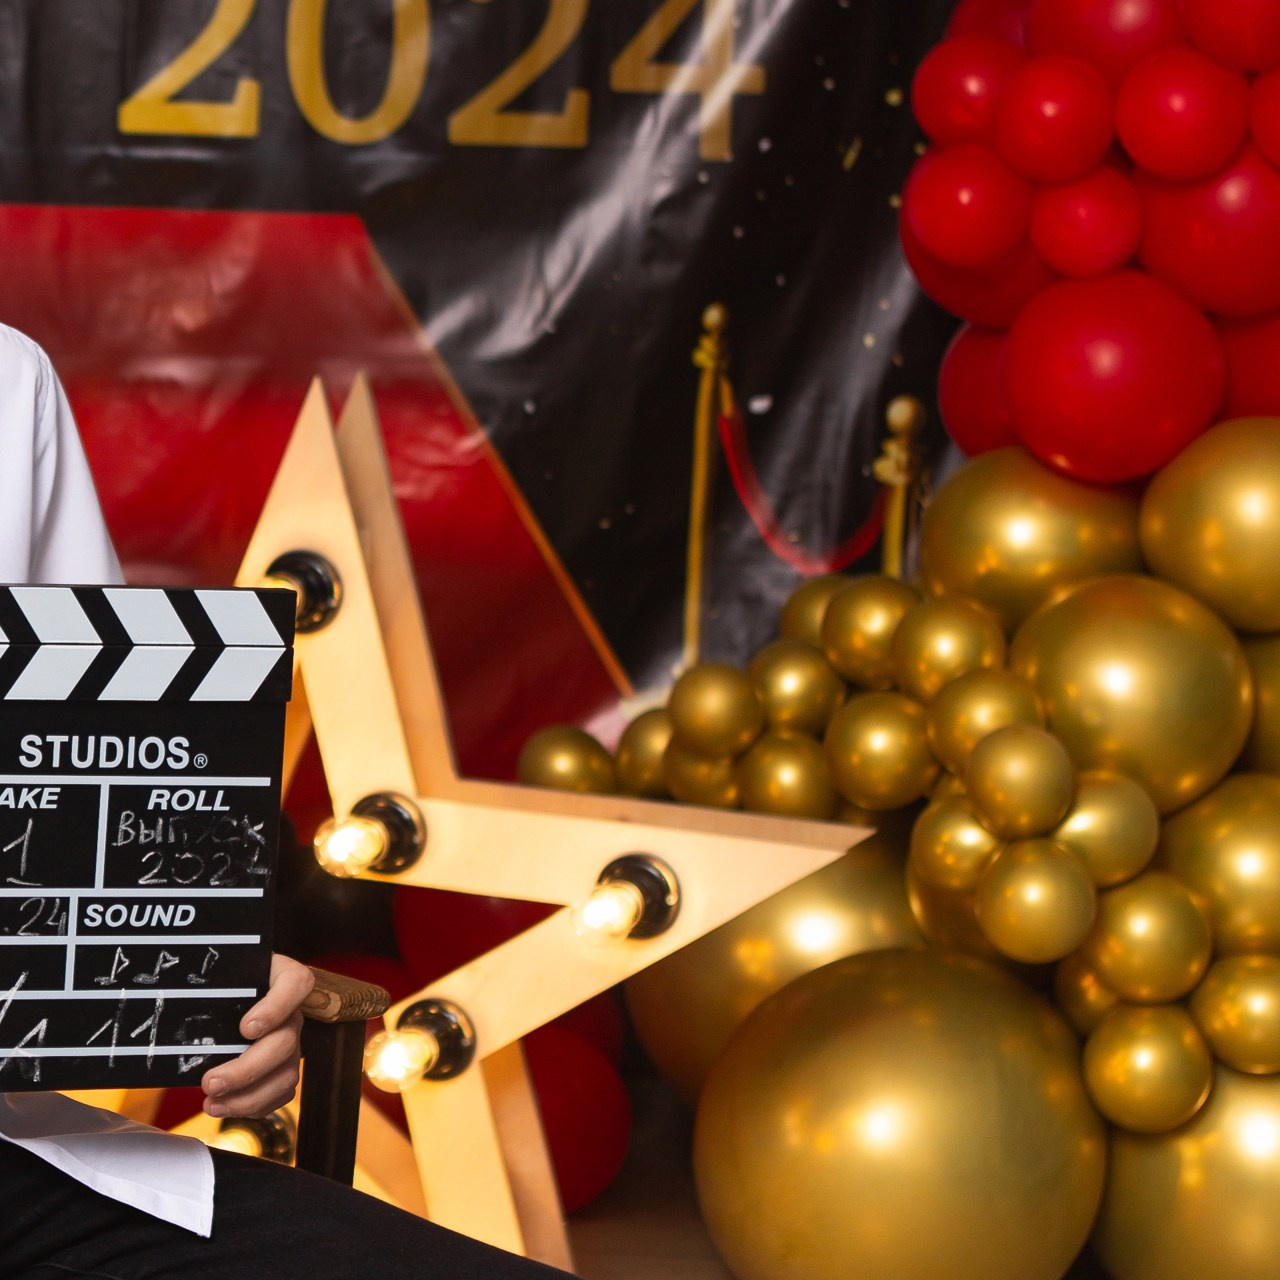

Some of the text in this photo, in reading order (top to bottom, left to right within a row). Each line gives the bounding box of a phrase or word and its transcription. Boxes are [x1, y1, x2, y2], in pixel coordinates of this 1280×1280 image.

[146, 789, 231, 812] ROLL
[2, 817, 44, 887] 1
[83, 903, 197, 928] SOUND
